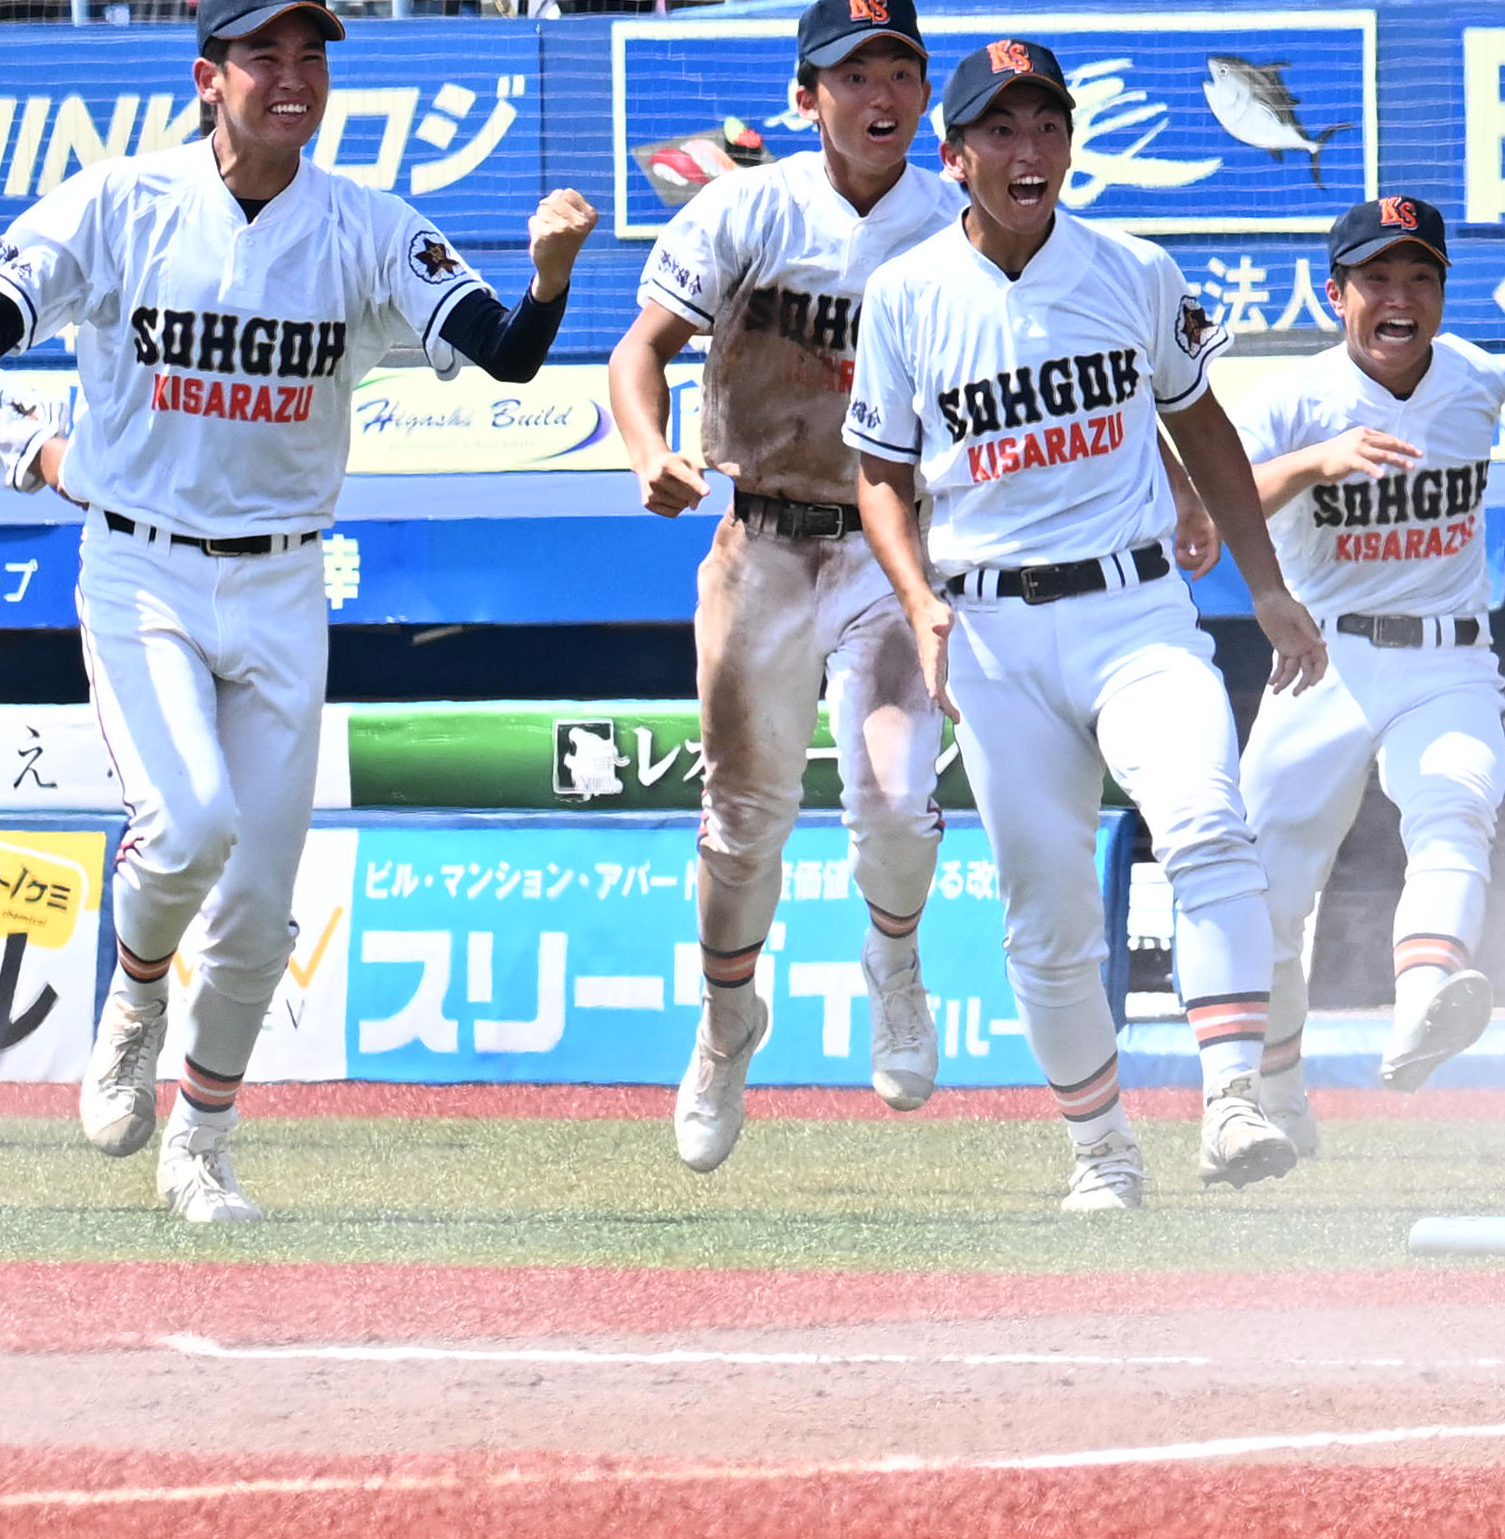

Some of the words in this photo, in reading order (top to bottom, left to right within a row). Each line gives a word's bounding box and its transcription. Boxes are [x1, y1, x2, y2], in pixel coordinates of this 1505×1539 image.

[986, 39, 1033, 74] KS
[1380, 195, 1418, 230] KS
[131, 306, 346, 379] SOHGOH
[151, 372, 316, 422] KISARAZU
[489, 397, 573, 429] Build
[938, 348, 1139, 446] SOHGOH
[968, 410, 1125, 484] KISARAZU
[1314, 459, 1490, 530] SOHGOH
[1335, 516, 1476, 563] KISARAZU
